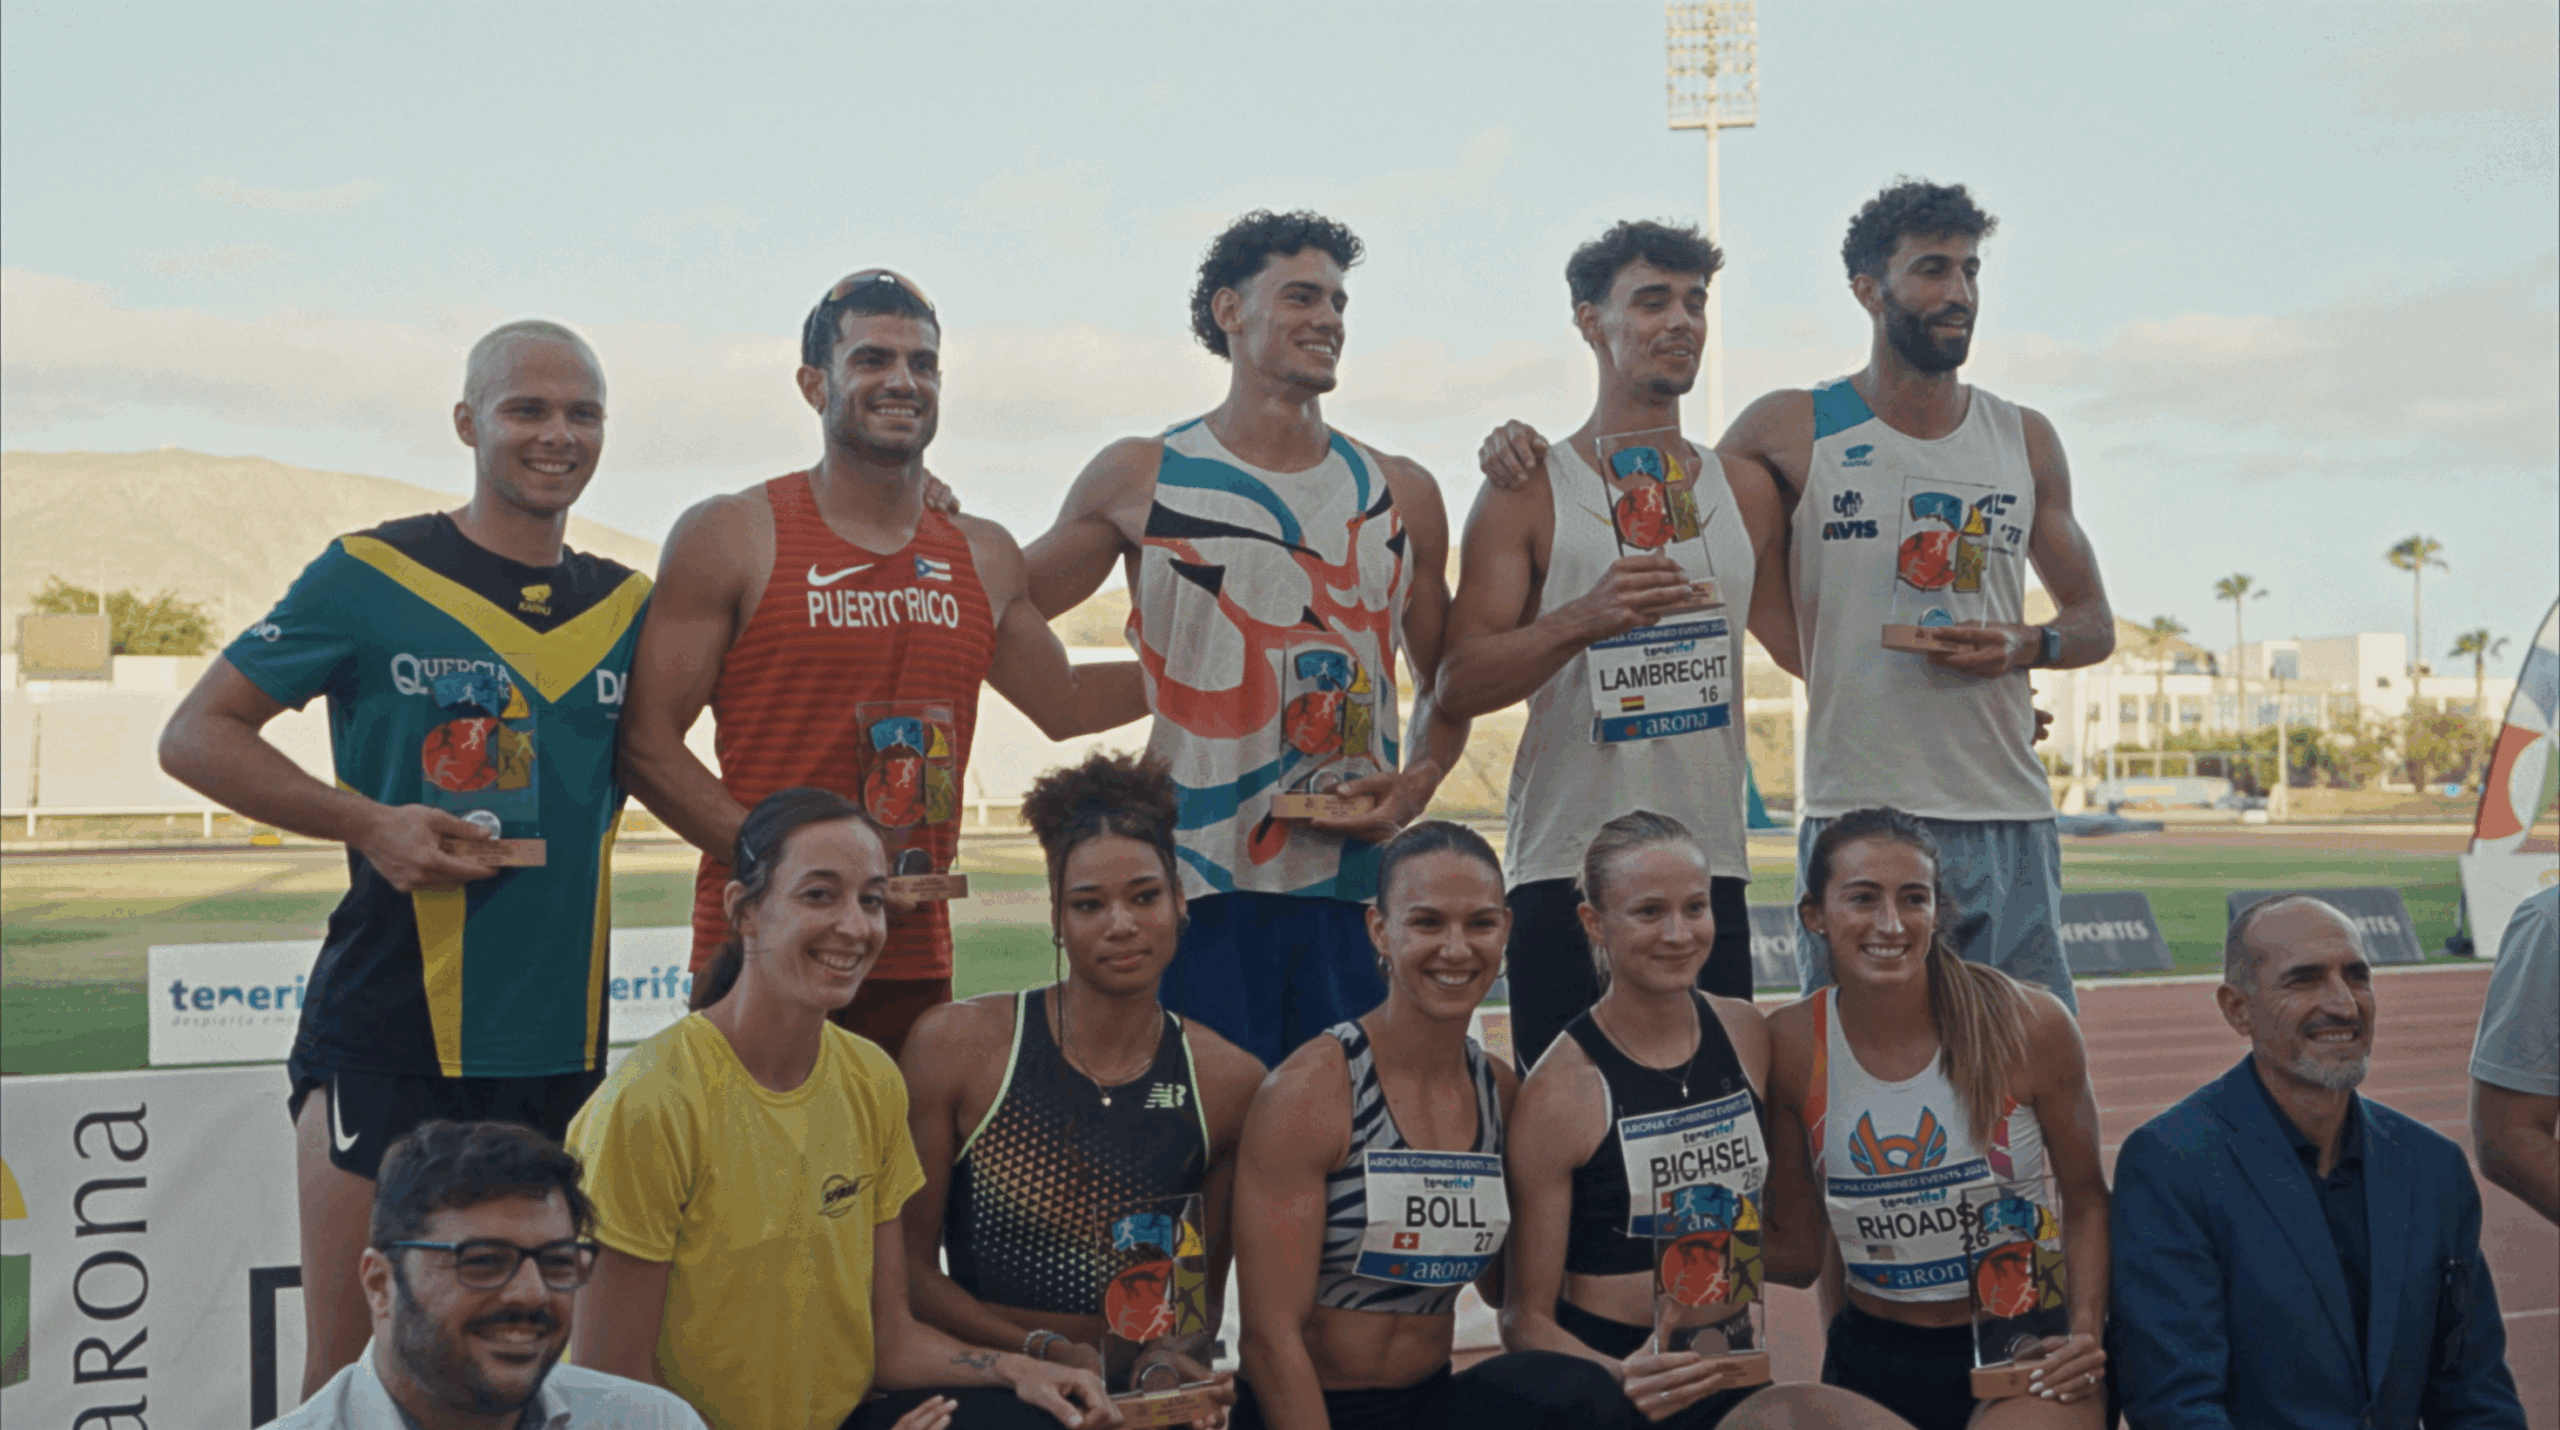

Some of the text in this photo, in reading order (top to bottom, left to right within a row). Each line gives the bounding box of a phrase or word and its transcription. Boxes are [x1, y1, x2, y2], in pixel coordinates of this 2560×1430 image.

[1822, 519, 1879, 541] AVIS
[807, 586, 960, 629] PUERTO RICO
[1600, 655, 1728, 692] LAMBRECHT
[1699, 684, 1719, 704] 16
[1624, 1119, 1666, 1135] ARONA
[1666, 1107, 1716, 1128] COMBINED
[1370, 1157, 1409, 1168] ARONA
[1411, 1157, 1455, 1169] COMBINED
[1456, 1159, 1485, 1171] EVENTS
[1650, 1135, 1758, 1189] BICHSEL
[1741, 1166, 1763, 1191] 25
[1861, 1177, 1919, 1192] COMBINED
[1919, 1170, 1962, 1186] EVENTS
[1405, 1195, 1487, 1228] BOLL
[1856, 1201, 1979, 1240] RHOADS
[1473, 1231, 1495, 1253] 27
[1958, 1231, 1991, 1253] 26
